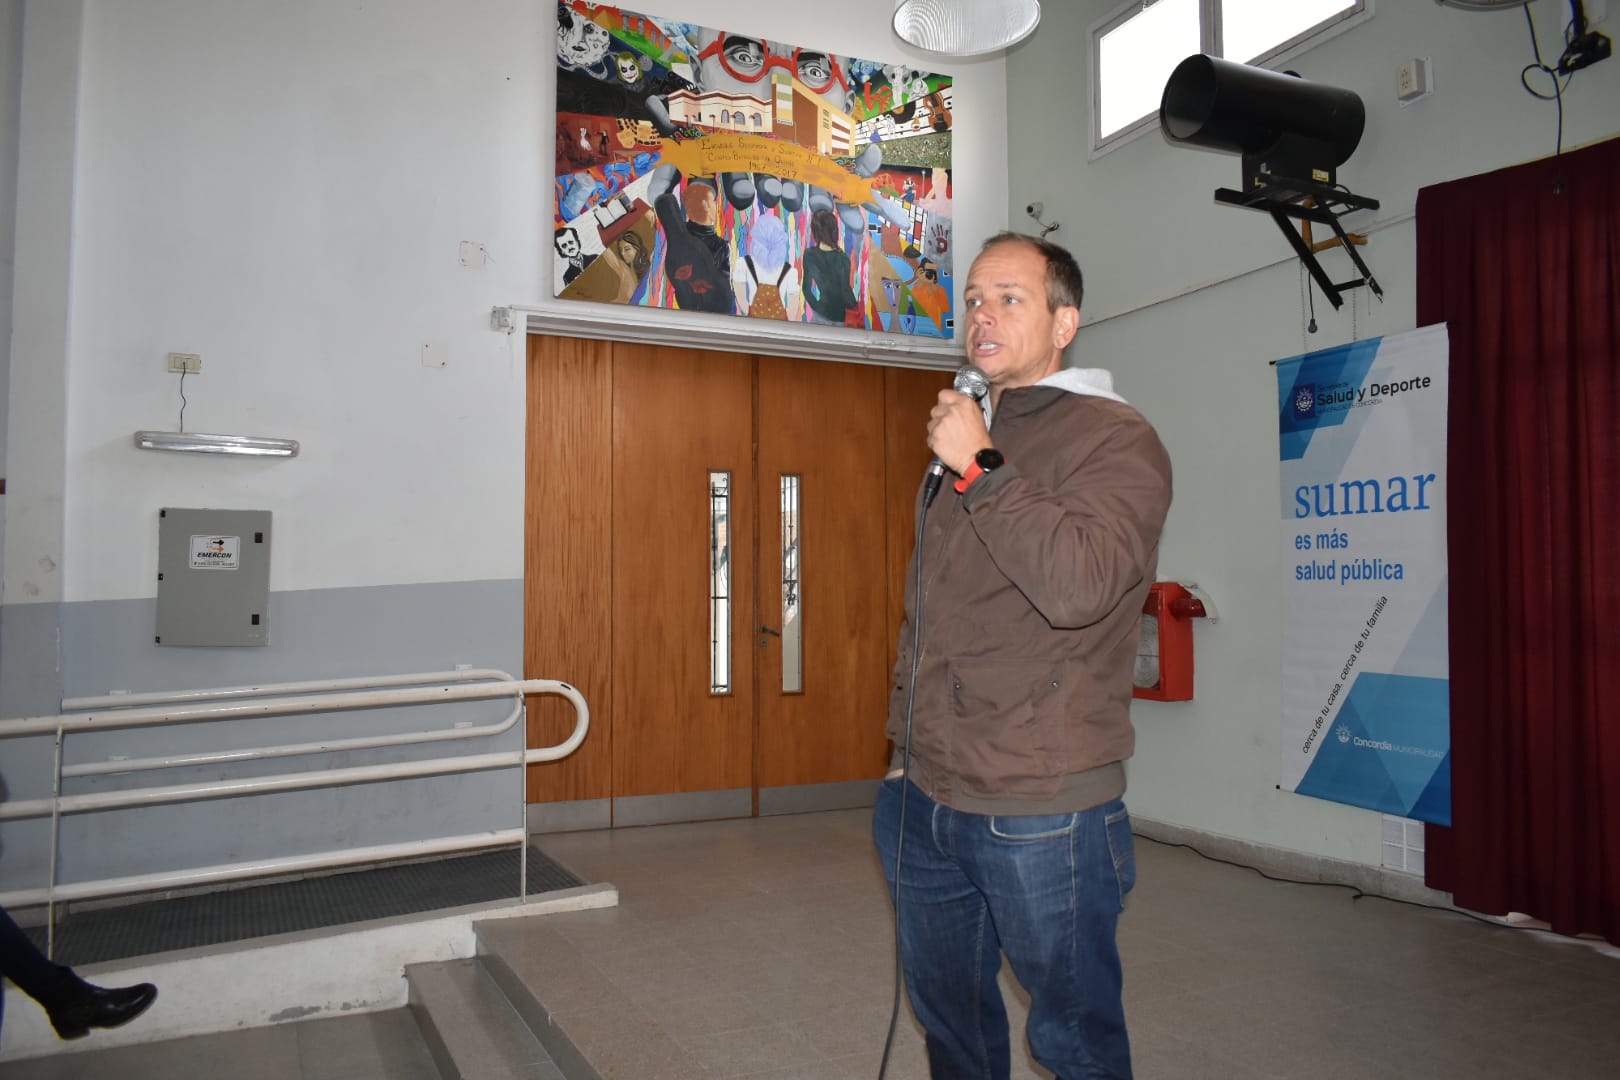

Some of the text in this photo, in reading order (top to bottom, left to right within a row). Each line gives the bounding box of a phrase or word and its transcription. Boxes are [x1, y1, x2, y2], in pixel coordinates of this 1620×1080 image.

[775, 167, 798, 177] 2017
[1317, 387, 1353, 406] Salud
[1357, 387, 1366, 401] y
[1370, 376, 1431, 397] Deporte
[1295, 473, 1436, 519] sumar
[1295, 528, 1349, 550] es más
[1295, 558, 1404, 586] salud pública
[1302, 728, 1318, 754] cerca
[1315, 716, 1324, 729] de
[1321, 705, 1330, 716] tu
[1340, 653, 1357, 680] cerca
[1354, 640, 1364, 654] de
[1360, 628, 1371, 640] tu
[1366, 595, 1388, 629] familia
[1353, 736, 1393, 751] Concordia
